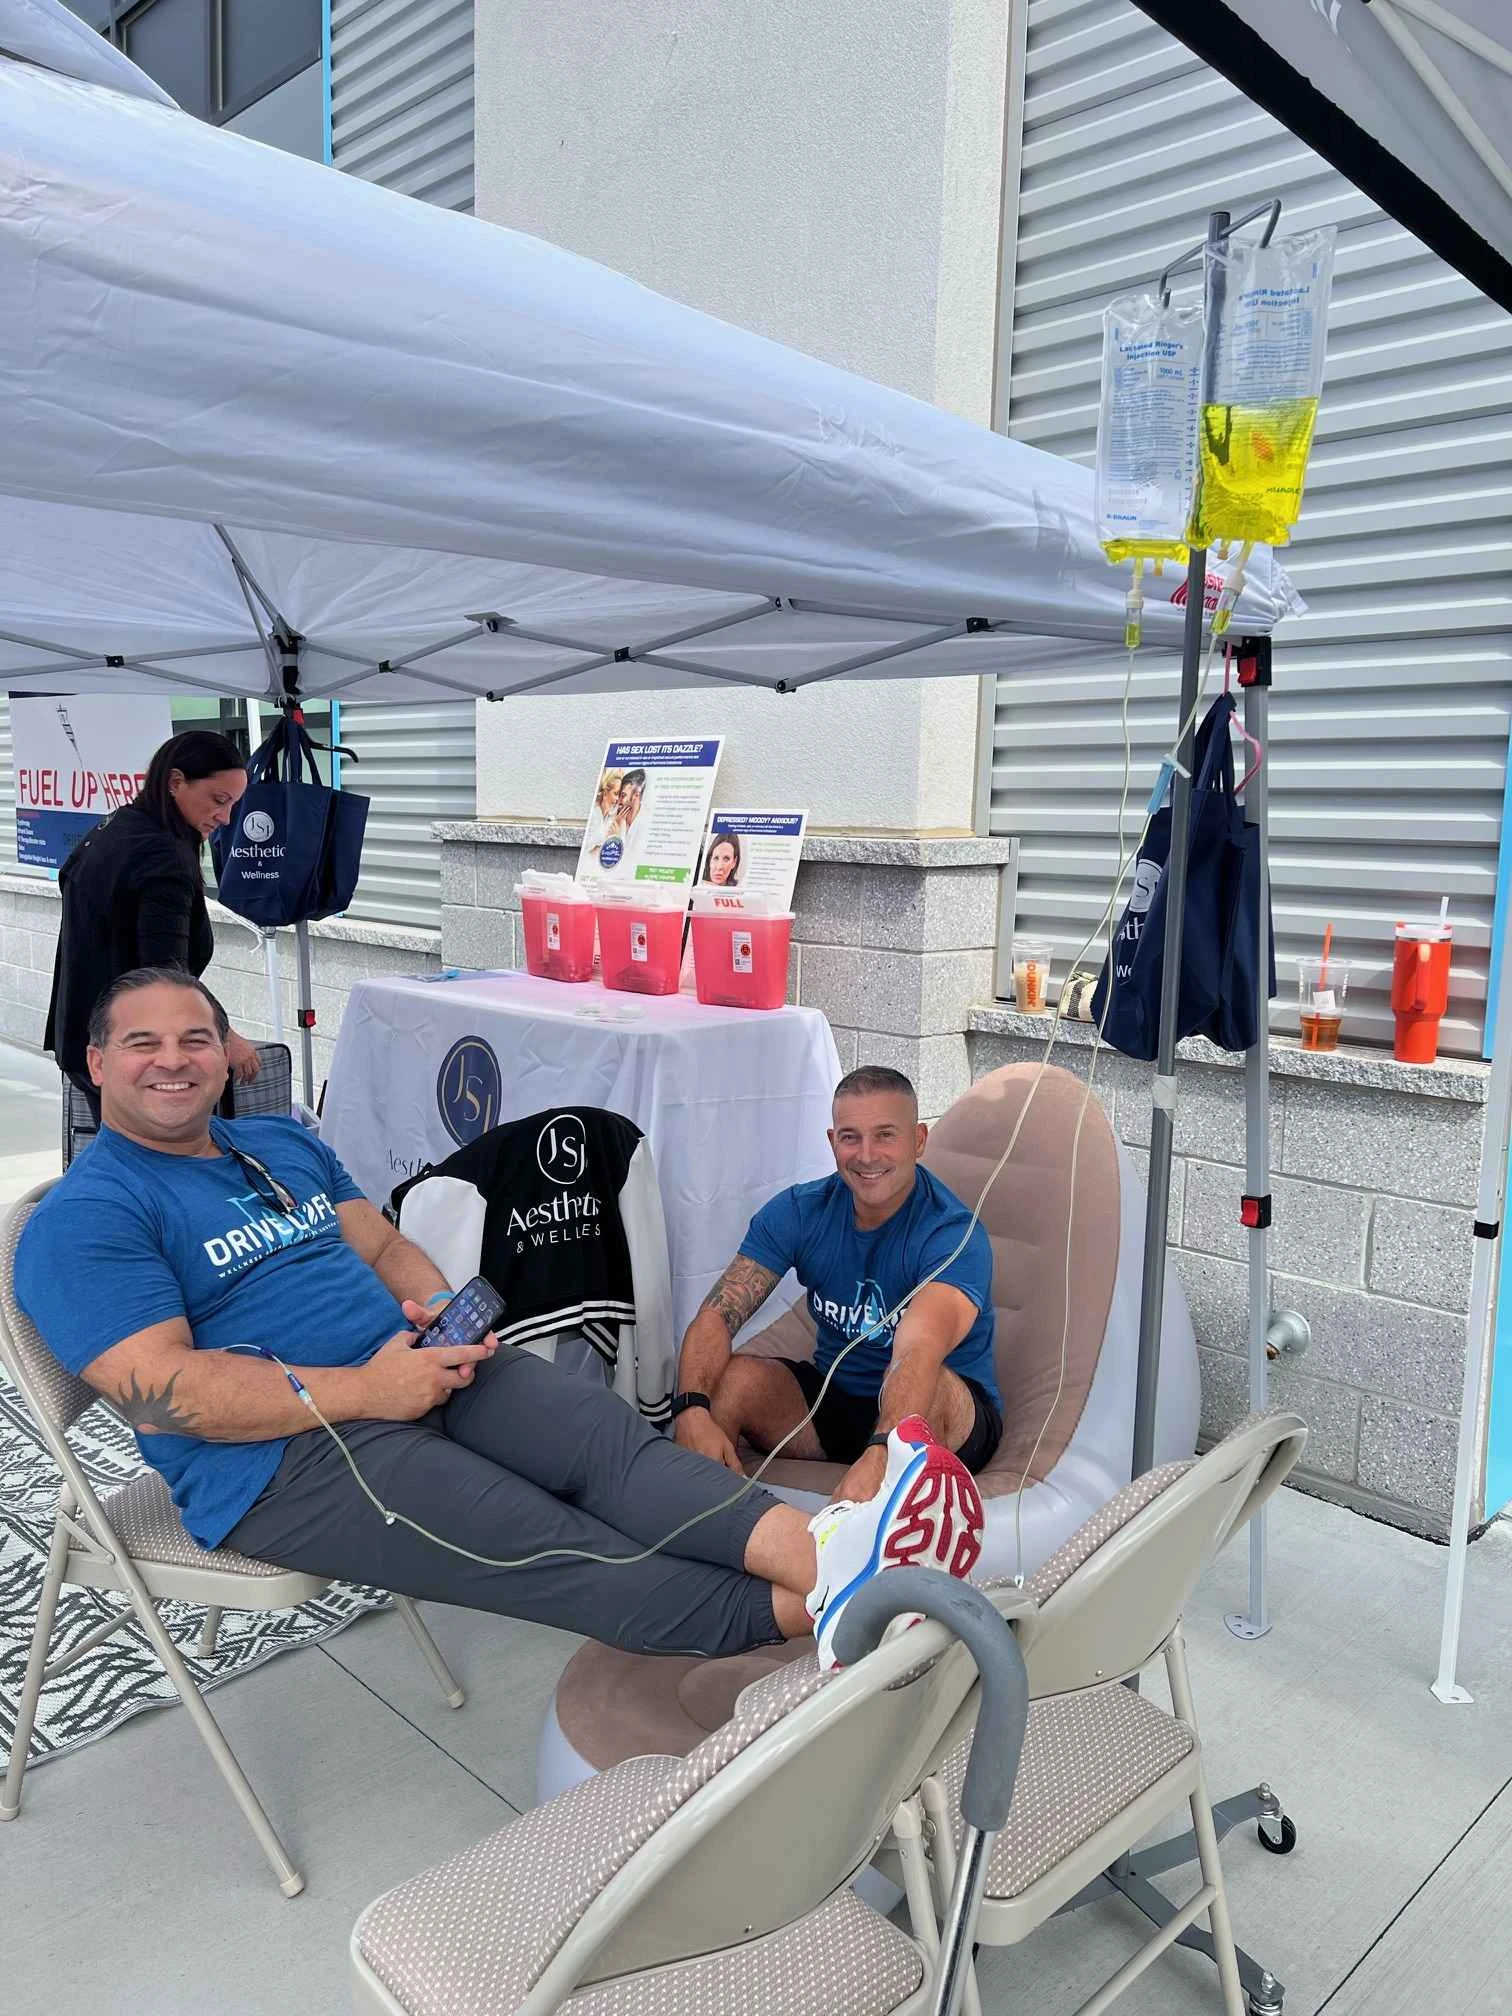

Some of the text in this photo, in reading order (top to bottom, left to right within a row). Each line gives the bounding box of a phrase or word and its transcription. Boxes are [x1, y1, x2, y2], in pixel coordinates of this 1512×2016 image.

[1127, 350, 1160, 360] Injection
[616, 745, 631, 755] HAS
[631, 745, 645, 755] SEX
[645, 745, 661, 754] LOST
[673, 743, 704, 753] DAZZLE?
[19, 769, 64, 806] FUEL
[72, 771, 98, 809] UP
[749, 816, 771, 825] MOODY?
[241, 871, 280, 880] Wellness
[713, 897, 744, 908] FULL
[203, 1216, 294, 1267] DRIVE
[516, 1240, 524, 1254] &
[813, 1290, 878, 1325] DRIVE
